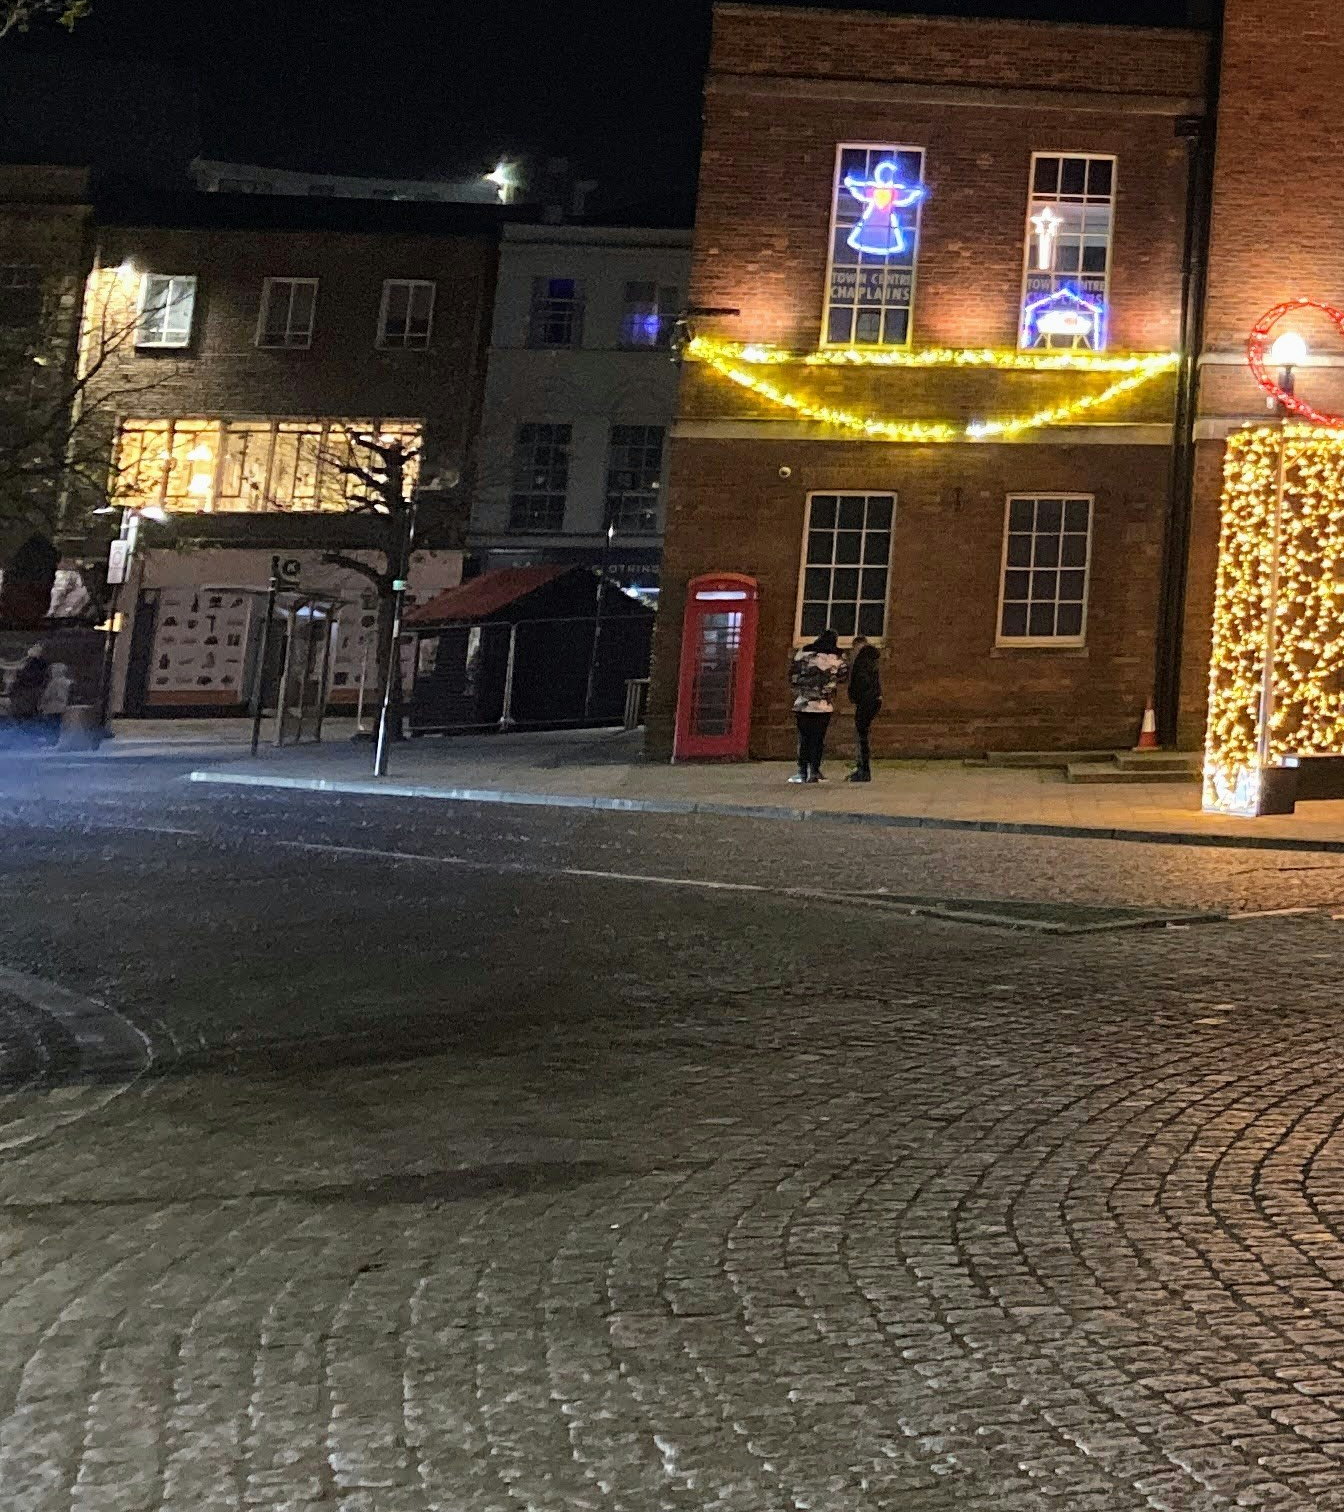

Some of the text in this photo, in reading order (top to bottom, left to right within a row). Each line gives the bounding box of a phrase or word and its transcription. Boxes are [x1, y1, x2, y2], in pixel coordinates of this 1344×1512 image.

[832, 272, 914, 285] TOWN CENTRE
[831, 285, 911, 301] CHAPLAINS
